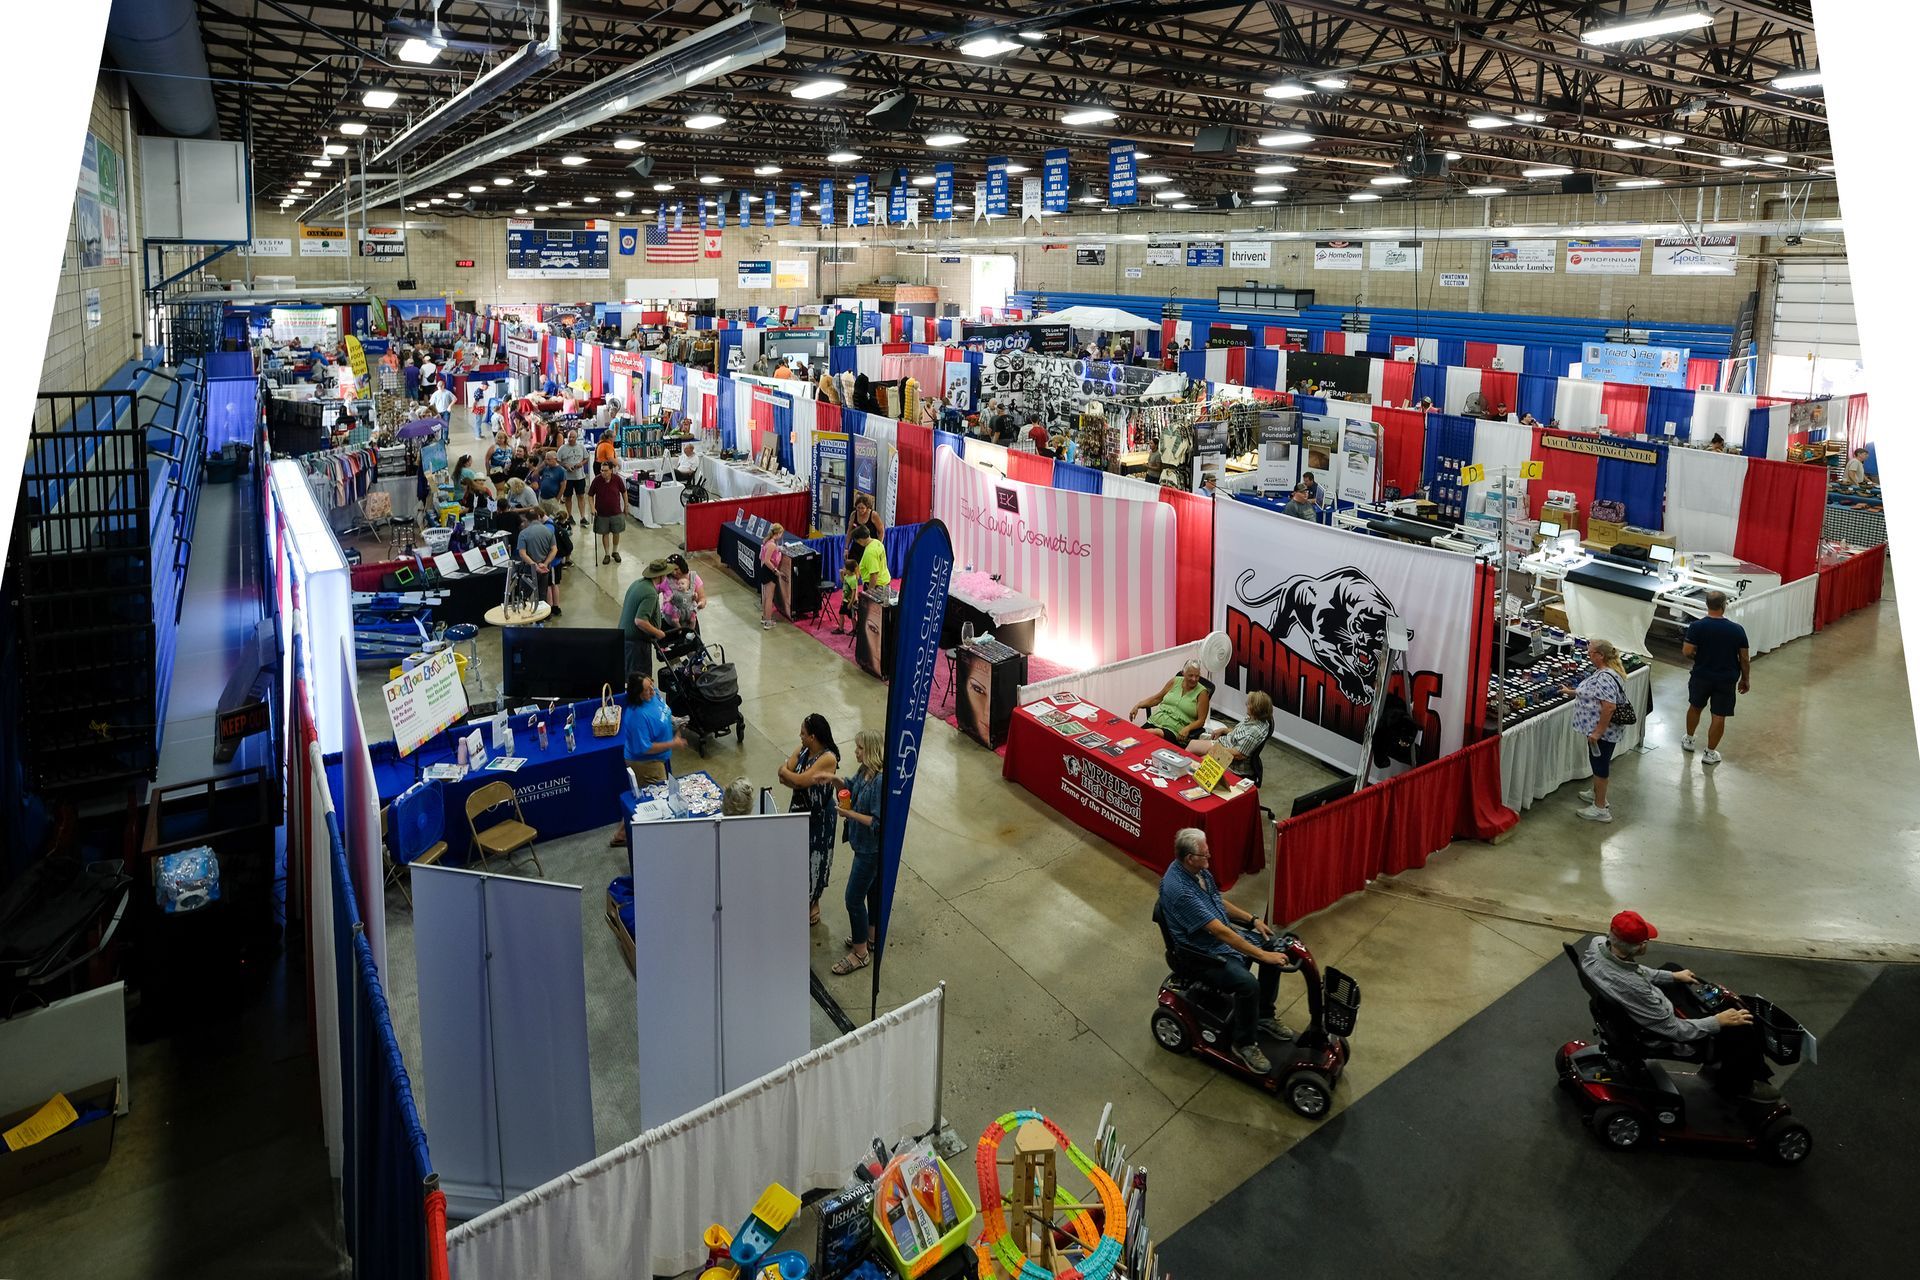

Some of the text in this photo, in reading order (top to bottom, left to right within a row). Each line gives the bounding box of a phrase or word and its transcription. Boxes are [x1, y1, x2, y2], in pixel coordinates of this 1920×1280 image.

[1703, 235, 1731, 245] TAPING
[1232, 251, 1267, 261] thrivent
[1328, 251, 1362, 259] HomeTown
[1491, 263, 1554, 271] Alexander Lumber
[1005, 335, 1032, 352] City
[1212, 338, 1248, 346] metronet
[820, 446, 847, 454] CONCEPTS
[821, 440, 846, 448] WINDOW
[1546, 437, 1577, 449] VACUUM
[1585, 443, 1617, 456] SEWING
[1618, 449, 1652, 461] CENTER
[1571, 436, 1625, 448] FARIBAULT
[1468, 463, 1536, 482] D C
[999, 491, 1017, 509] EK
[1017, 519, 1092, 557] Cosmetics
[906, 554, 942, 721] MAYO CLINIC
[917, 559, 949, 722] HEALTH SYSTEM
[221, 713, 247, 737] KEEP
[513, 775, 571, 796] AYO CLINIC
[1082, 758, 1142, 807] NRHEG
[507, 786, 570, 806] HALTH SYSTEM
[1081, 775, 1141, 820] High School
[1061, 781, 1141, 838] Home of the PANTHERS
